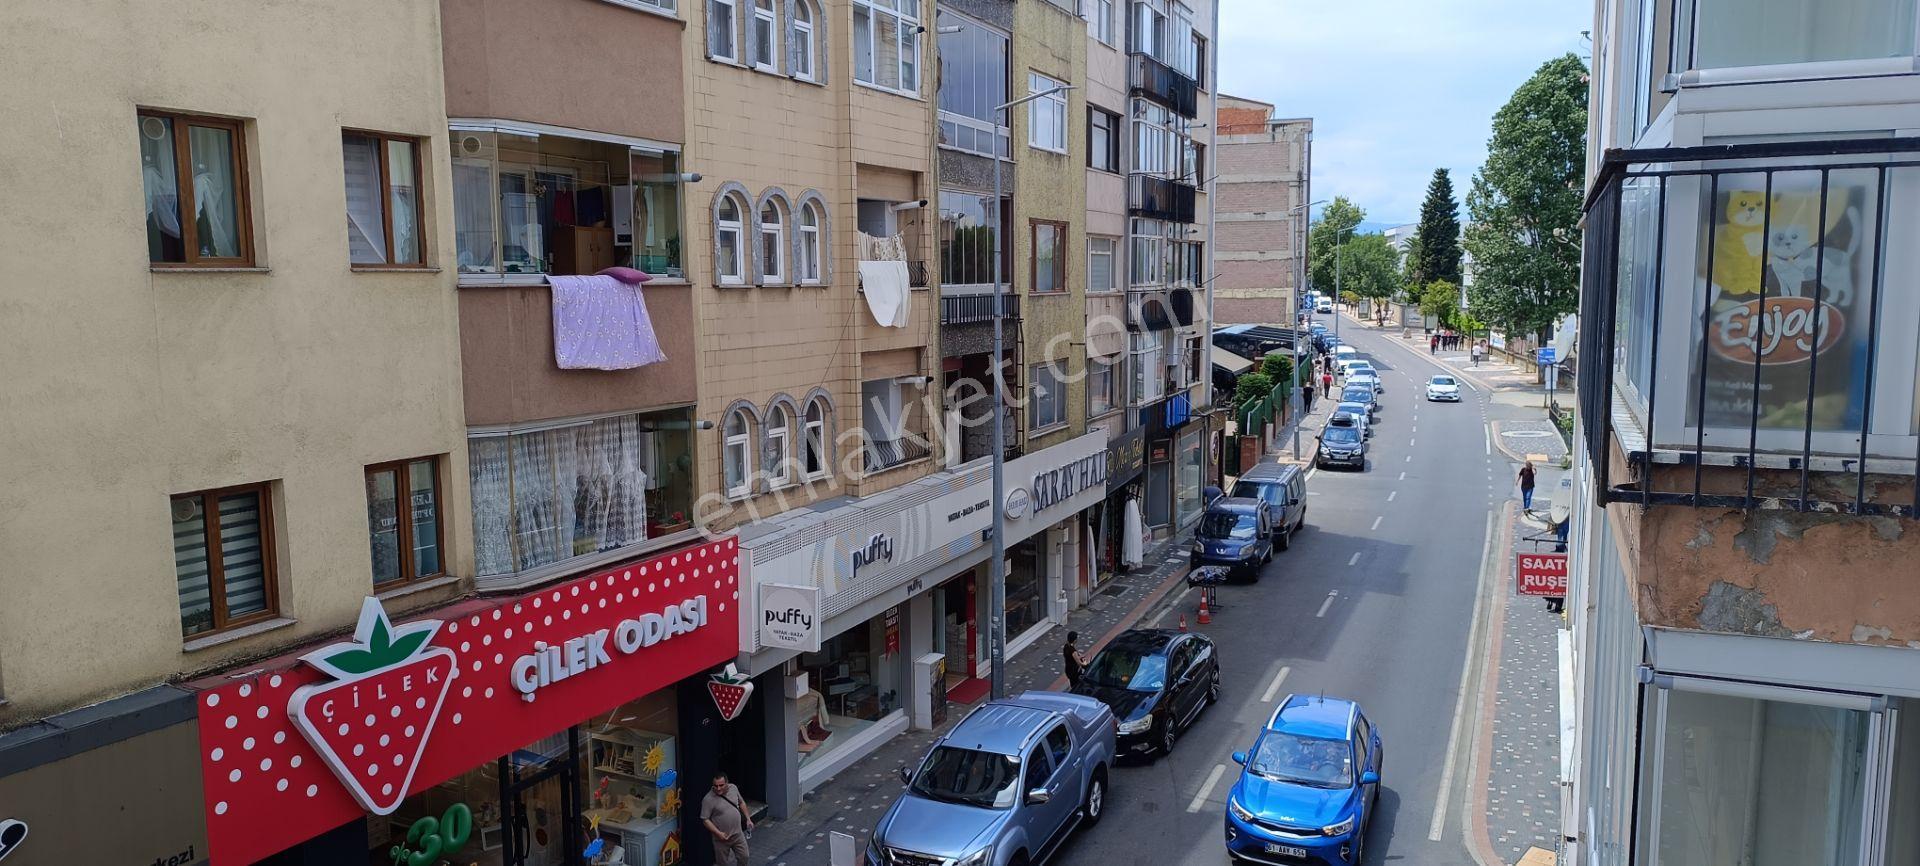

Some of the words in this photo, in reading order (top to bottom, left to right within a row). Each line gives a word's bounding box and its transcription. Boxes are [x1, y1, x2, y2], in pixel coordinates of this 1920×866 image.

[1714, 304, 1830, 356] Enjoy
[1033, 461, 1078, 514] SARAY
[849, 532, 893, 579] puffy
[906, 578, 923, 597] puffy
[765, 608, 811, 630] puffy
[511, 627, 612, 703] ÇİLEK
[613, 594, 707, 654] ODASI
[322, 665, 439, 722] ÇİLEK
[150, 844, 195, 866] kezi
